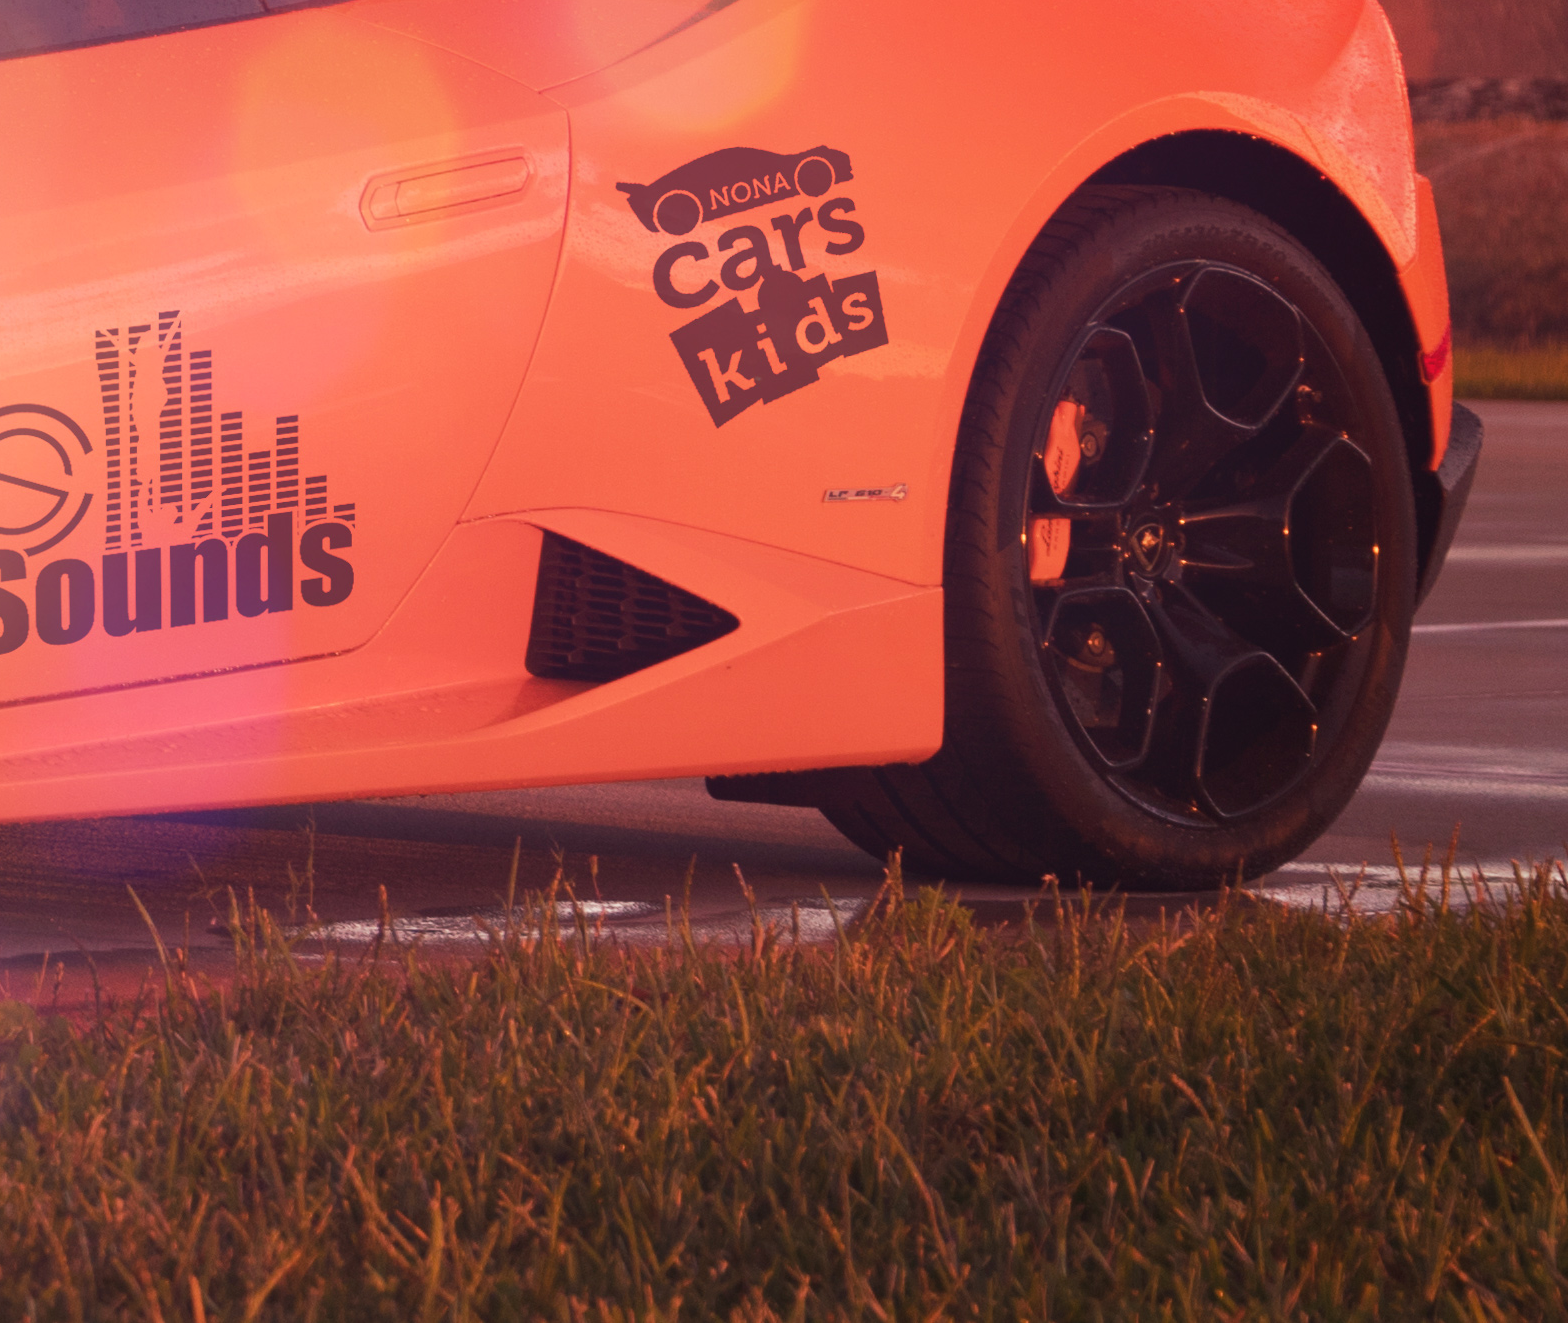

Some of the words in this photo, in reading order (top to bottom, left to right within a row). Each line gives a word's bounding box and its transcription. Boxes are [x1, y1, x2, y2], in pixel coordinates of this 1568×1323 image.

[709, 171, 791, 210] NONA
[652, 196, 865, 309] cars
[697, 291, 874, 404] kids
